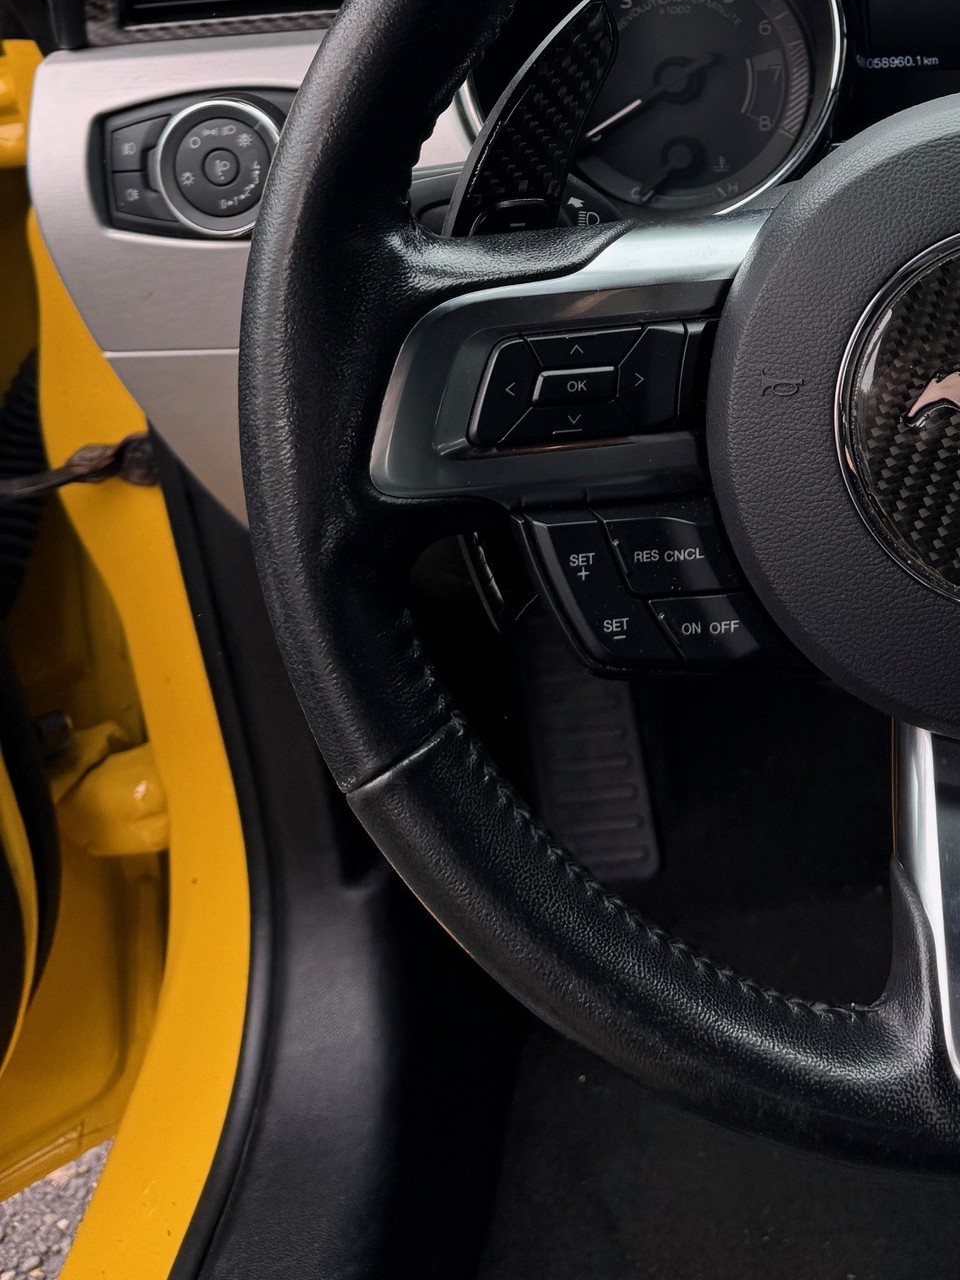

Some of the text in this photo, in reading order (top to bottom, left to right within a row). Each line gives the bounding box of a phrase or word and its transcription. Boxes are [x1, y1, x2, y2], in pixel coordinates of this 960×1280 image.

[758, 20, 771, 36] 6
[566, 379, 588, 393] OK
[569, 552, 596, 567] SET
[633, 547, 705, 563] RES CNCL
[603, 617, 629, 633] SET
[681, 620, 740, 635] ON OFF
